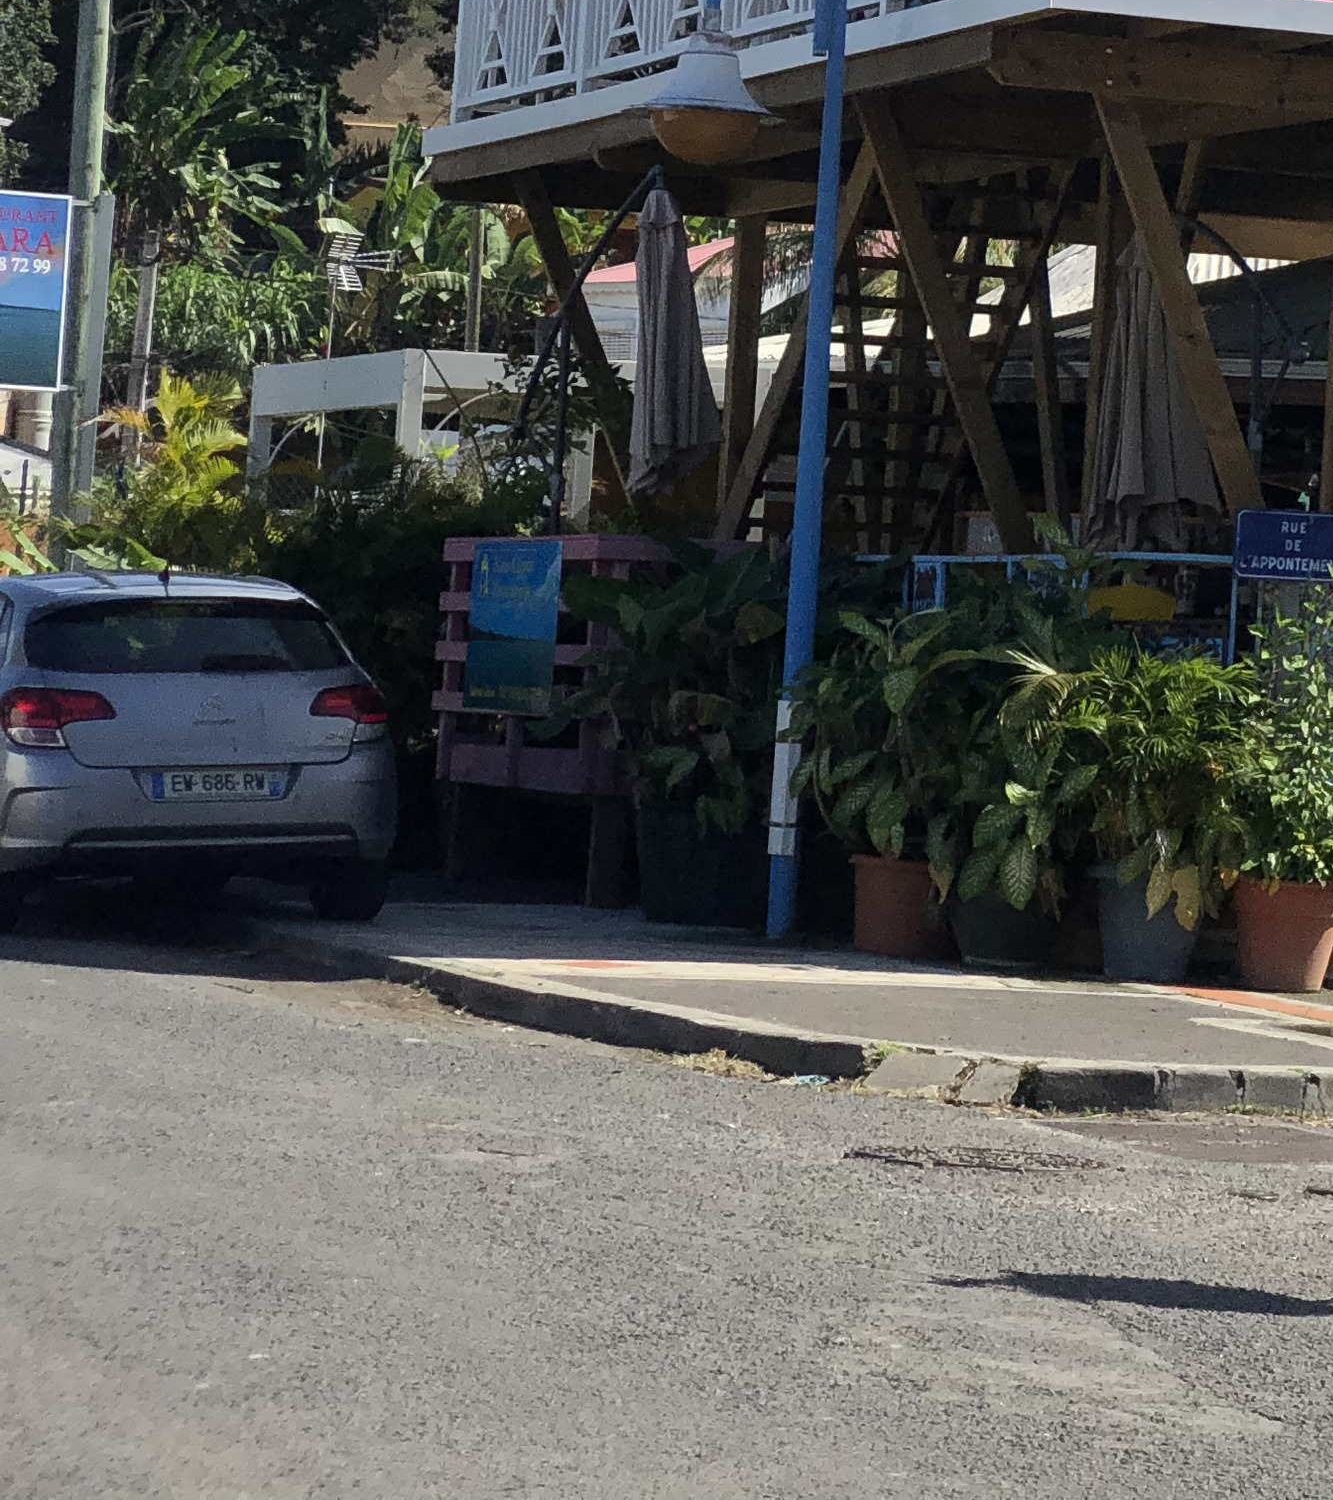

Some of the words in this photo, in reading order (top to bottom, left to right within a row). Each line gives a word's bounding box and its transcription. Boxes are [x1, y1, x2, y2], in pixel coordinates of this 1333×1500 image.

[11, 257, 30, 273] 72
[32, 258, 51, 275] 99
[1281, 521, 1308, 534] RUE
[1285, 539, 1301, 552] DE
